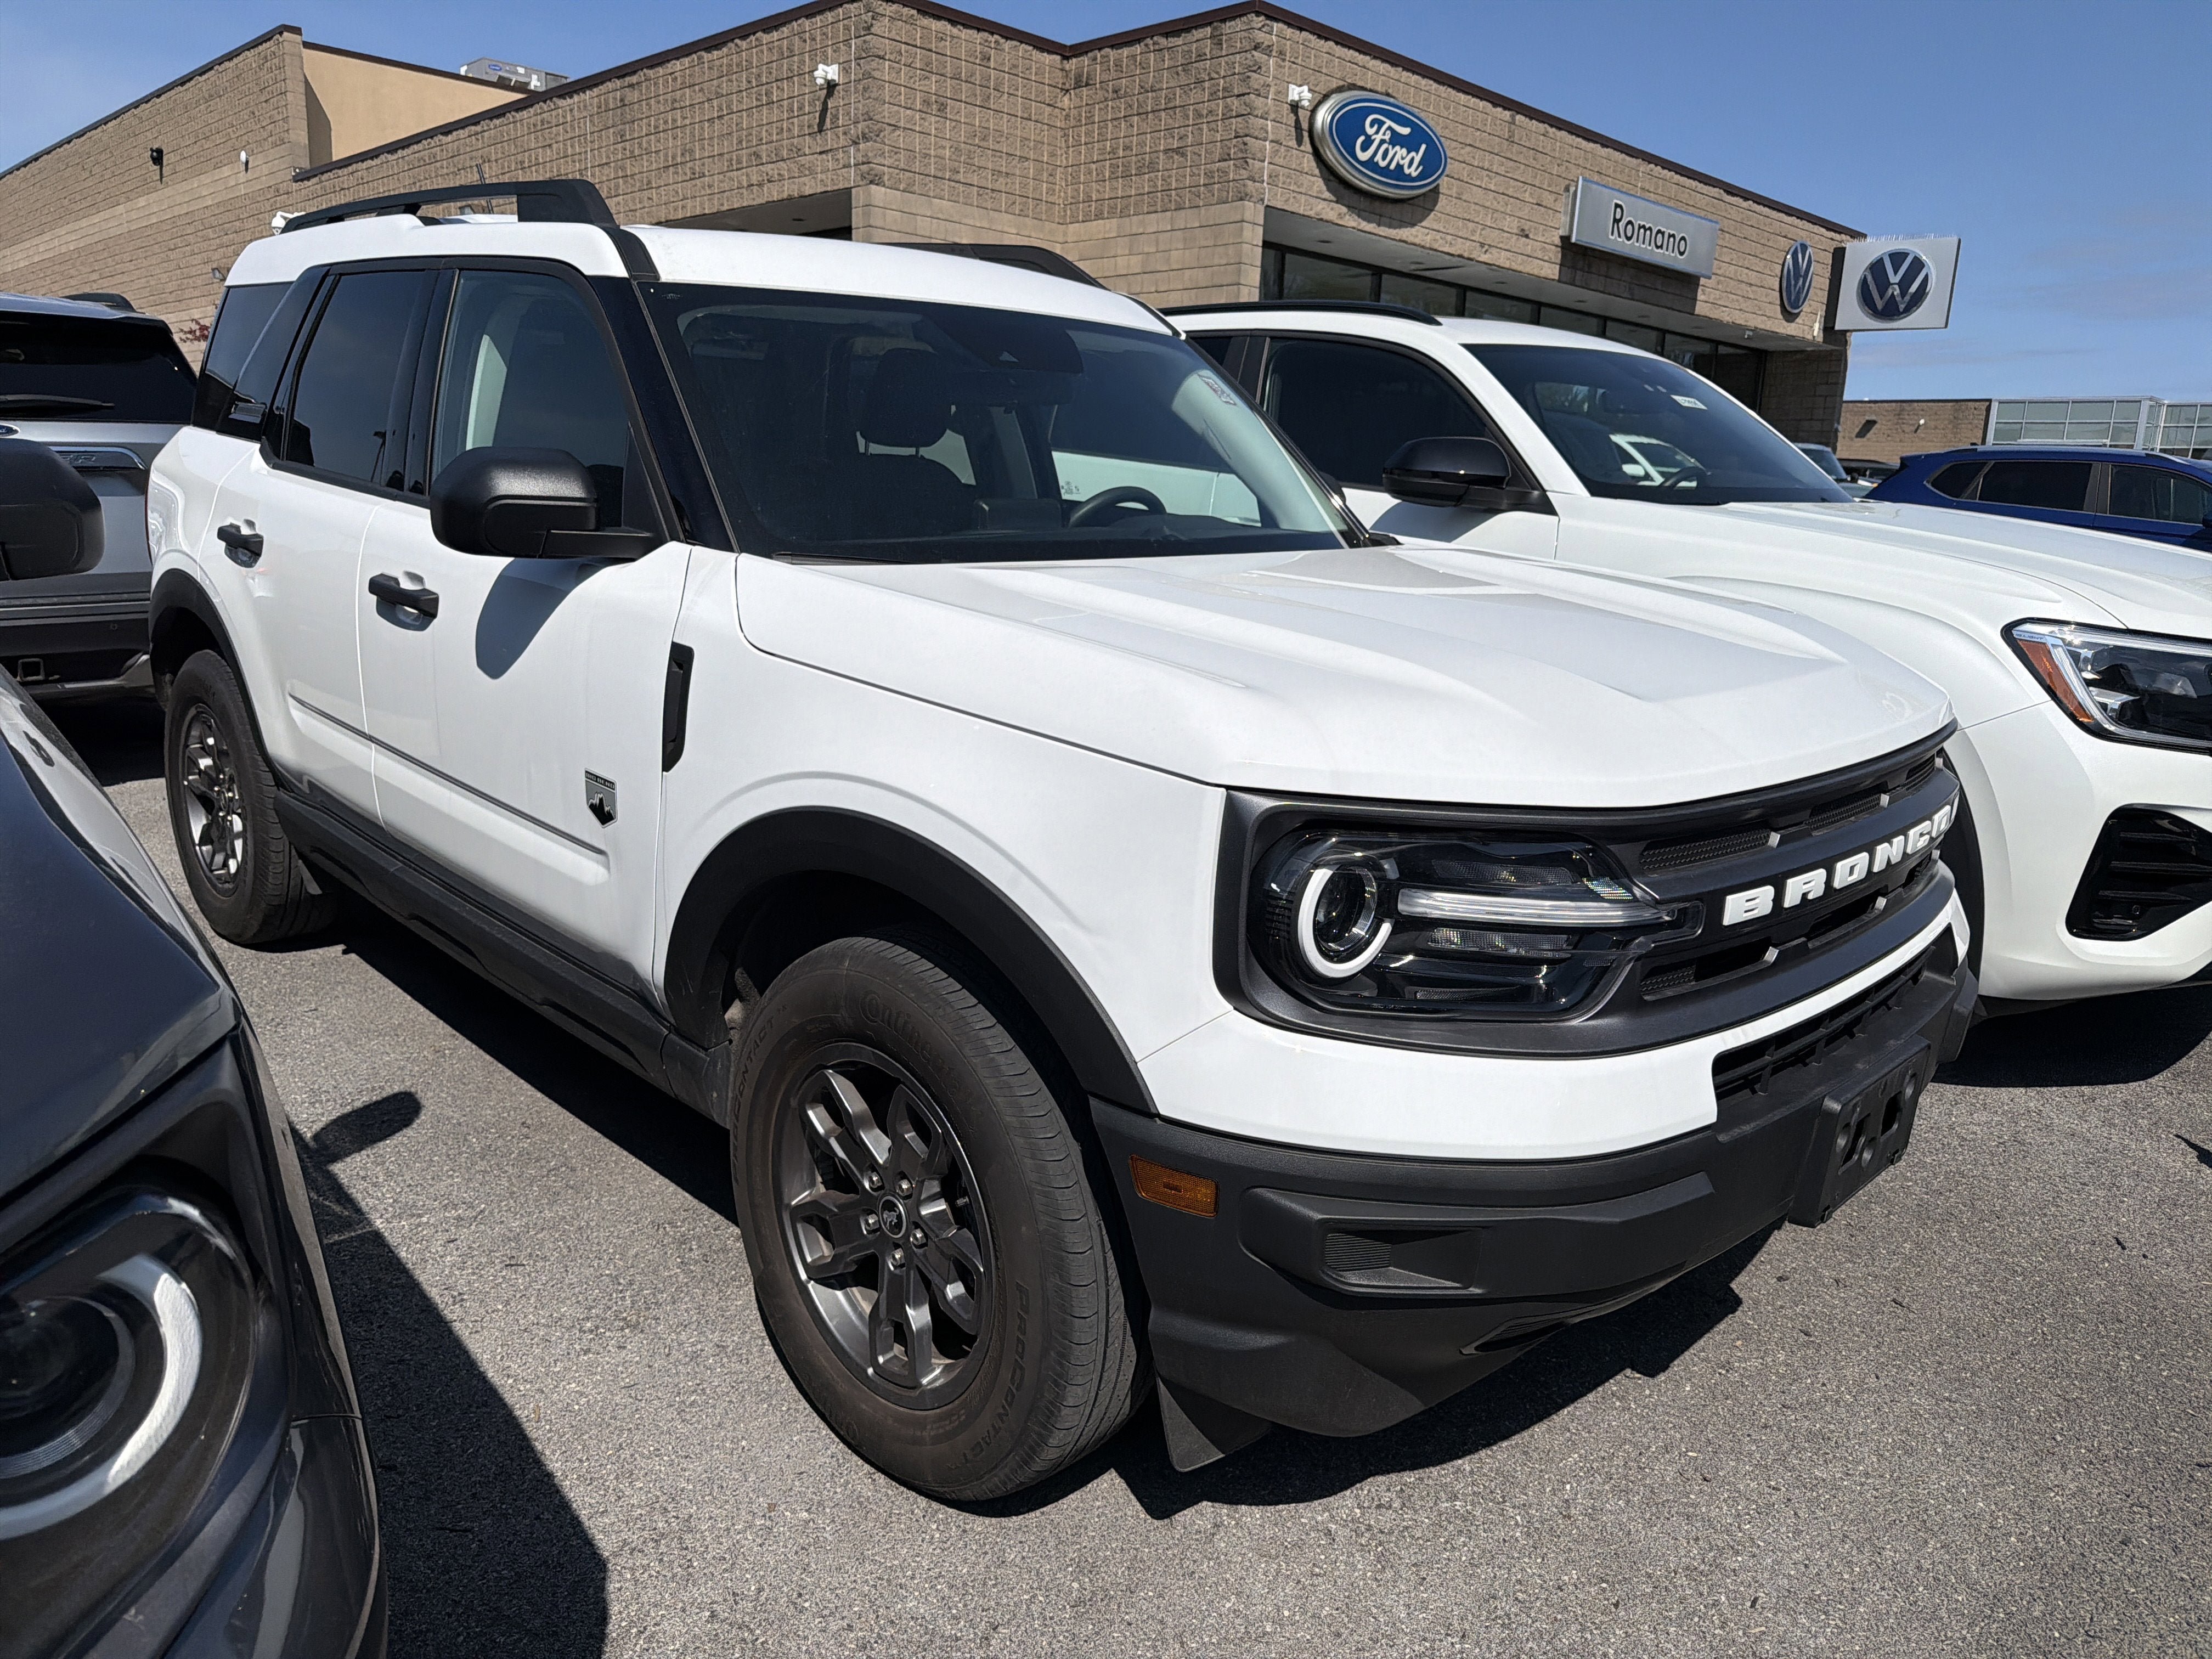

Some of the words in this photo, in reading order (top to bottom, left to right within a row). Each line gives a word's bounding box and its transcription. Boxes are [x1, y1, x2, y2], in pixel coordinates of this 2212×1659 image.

[1356, 114, 1426, 177] Ford
[1610, 200, 1688, 258] Romano
[1723, 805, 1951, 926] BRONCO
